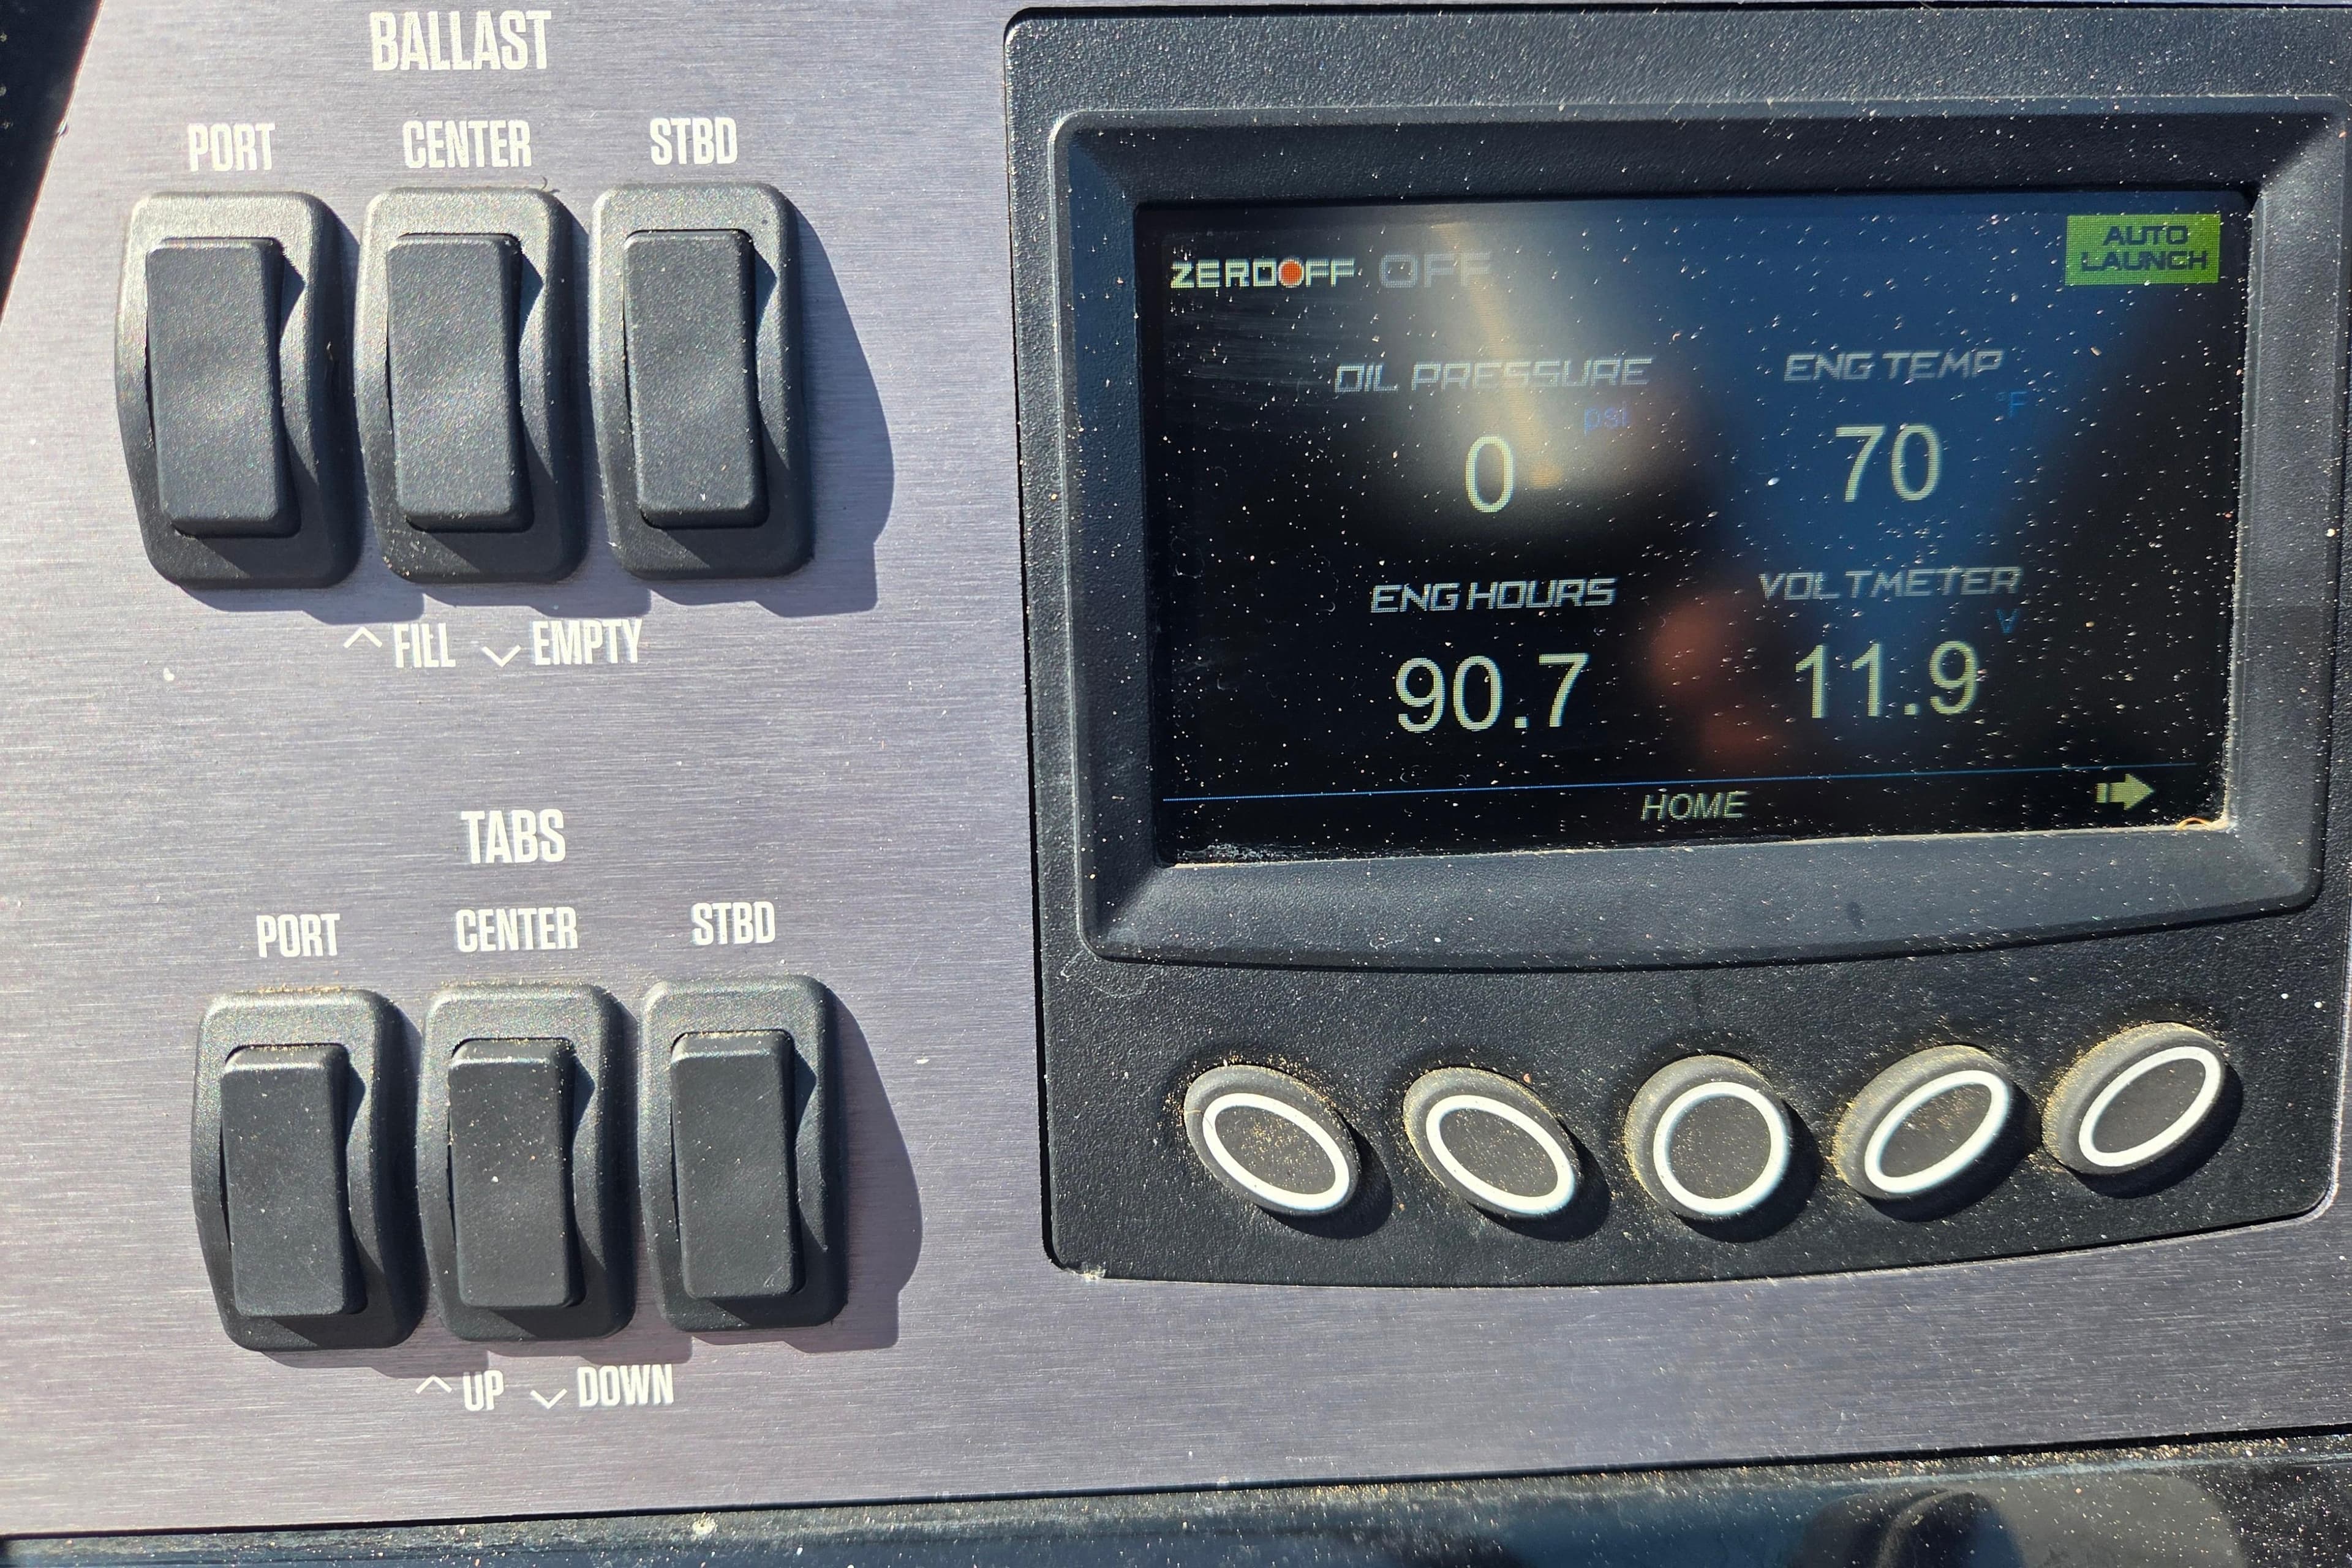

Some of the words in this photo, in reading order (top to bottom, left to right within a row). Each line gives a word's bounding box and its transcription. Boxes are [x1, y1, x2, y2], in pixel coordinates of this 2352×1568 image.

[369, 10, 552, 72] BALLAST
[187, 123, 276, 172] PORT
[403, 120, 532, 169] CENTER
[649, 117, 738, 166] STBD
[2103, 225, 2188, 246] AUTO
[1378, 252, 1493, 288] OFF
[2081, 250, 2209, 273] LAUNCH
[1334, 364, 1400, 393] OIL
[1411, 356, 1654, 391] PRESSURE
[1784, 353, 1874, 381] ENG
[1882, 350, 2004, 379] TEMP
[1583, 401, 1628, 436] psi
[1466, 435, 1515, 513] 0
[1836, 424, 1942, 503] 70
[1370, 582, 1460, 613] ENG
[1468, 578, 1619, 610] HOURS
[1759, 567, 2024, 600] VOLTMETER
[393, 623, 456, 668] FILL
[532, 619, 642, 665] EMPTY
[1995, 609, 2019, 634] V
[1395, 653, 1589, 733] 90.7
[1795, 641, 1980, 719] 11.9
[1640, 790, 1751, 821] HOME
[461, 809, 565, 864] TABS
[257, 913, 340, 957] PORT
[455, 907, 578, 952] CENTER
[692, 902, 775, 946] STBD
[463, 1370, 503, 1412] UP
[577, 1364, 674, 1408] DOWN
